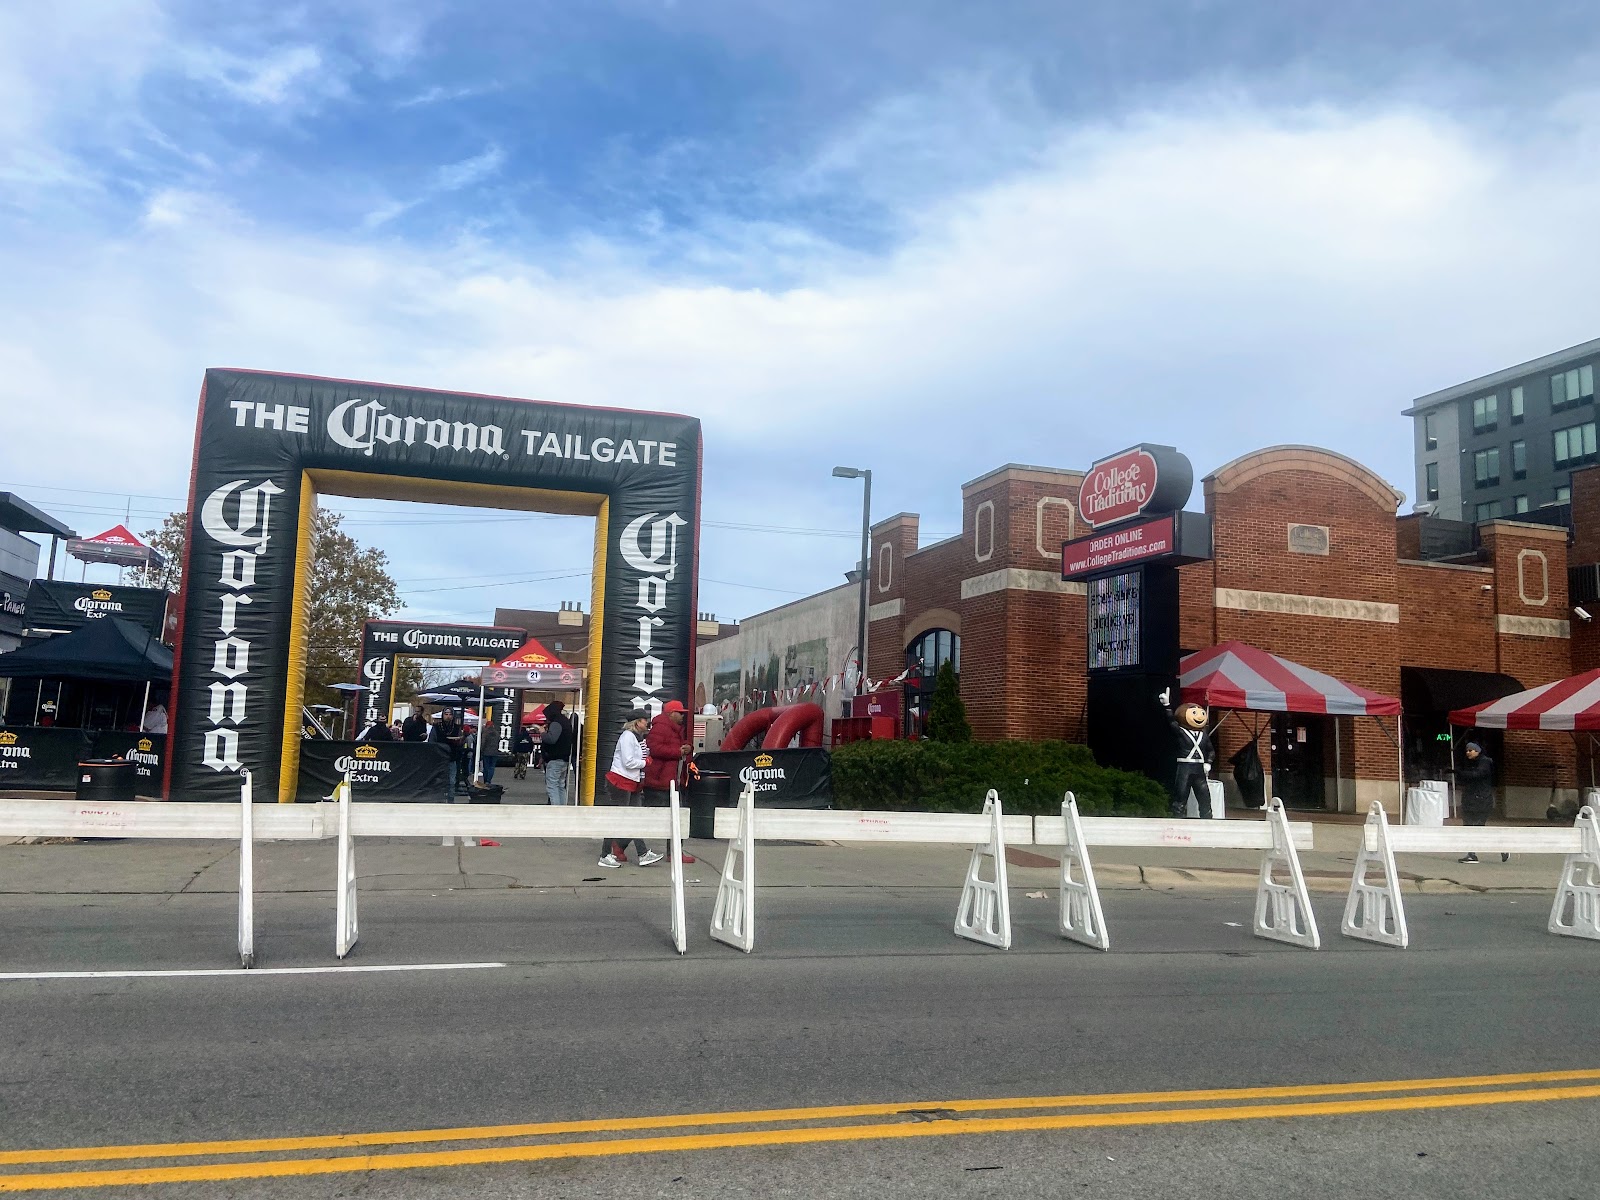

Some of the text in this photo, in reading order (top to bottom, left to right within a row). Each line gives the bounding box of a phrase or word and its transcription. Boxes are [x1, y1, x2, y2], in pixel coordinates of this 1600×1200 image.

[229, 398, 677, 467] THE Corona TAILGATE
[1094, 463, 1141, 495] College
[1085, 482, 1147, 515] Traditions
[1089, 528, 1143, 553] ORDER ONLINE
[1069, 540, 1166, 572] www.CollegeTraditions.com
[74, 596, 122, 613] Corona
[86, 609, 108, 619] Extr
[200, 478, 286, 773] Corona
[619, 511, 689, 731] Coron
[372, 629, 520, 649] THE Corona TAILGATE
[501, 660, 563, 669] Corona
[363, 657, 390, 724] Coro
[497, 688, 516, 754] orona
[0, 759, 18, 769] tra
[125, 748, 159, 766] Corona
[333, 755, 391, 773] Corona
[136, 764, 151, 777] xtra
[350, 772, 379, 783] Extra
[738, 765, 786, 784] Corona
[753, 781, 778, 792] Extra
